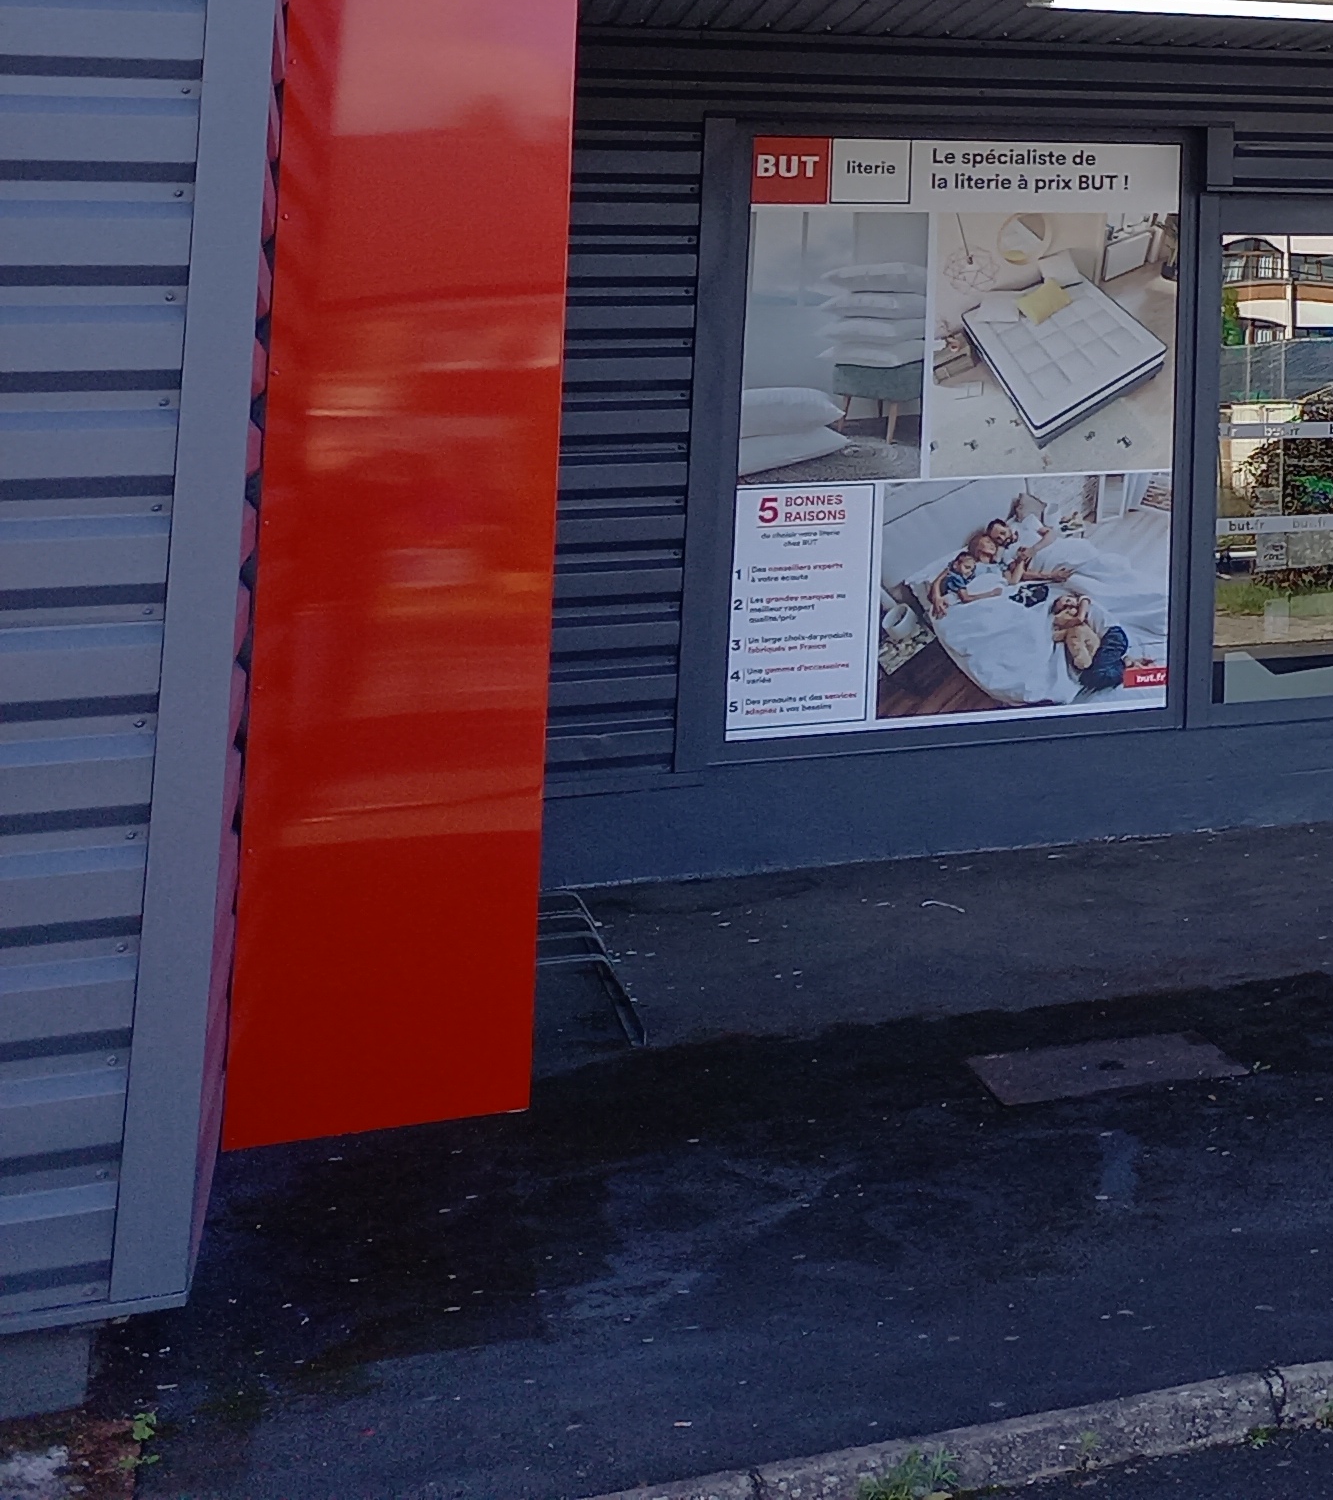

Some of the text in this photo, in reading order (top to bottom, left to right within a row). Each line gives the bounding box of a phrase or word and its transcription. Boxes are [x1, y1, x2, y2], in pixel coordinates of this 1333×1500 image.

[931, 147, 1097, 169] Le spécialiste de
[756, 154, 819, 178] BUT
[846, 160, 896, 175] literie
[931, 172, 1130, 195] la literie à prix BUT !
[784, 494, 843, 508] BONNES
[758, 497, 779, 524] 5
[784, 509, 846, 523] RAISONS
[1228, 519, 1264, 532] but.fr
[735, 569, 741, 580] 1
[733, 599, 743, 611] 2
[731, 639, 741, 651] 3
[730, 670, 740, 682] 4
[1136, 672, 1167, 684] but.fr
[728, 701, 738, 713] 5
